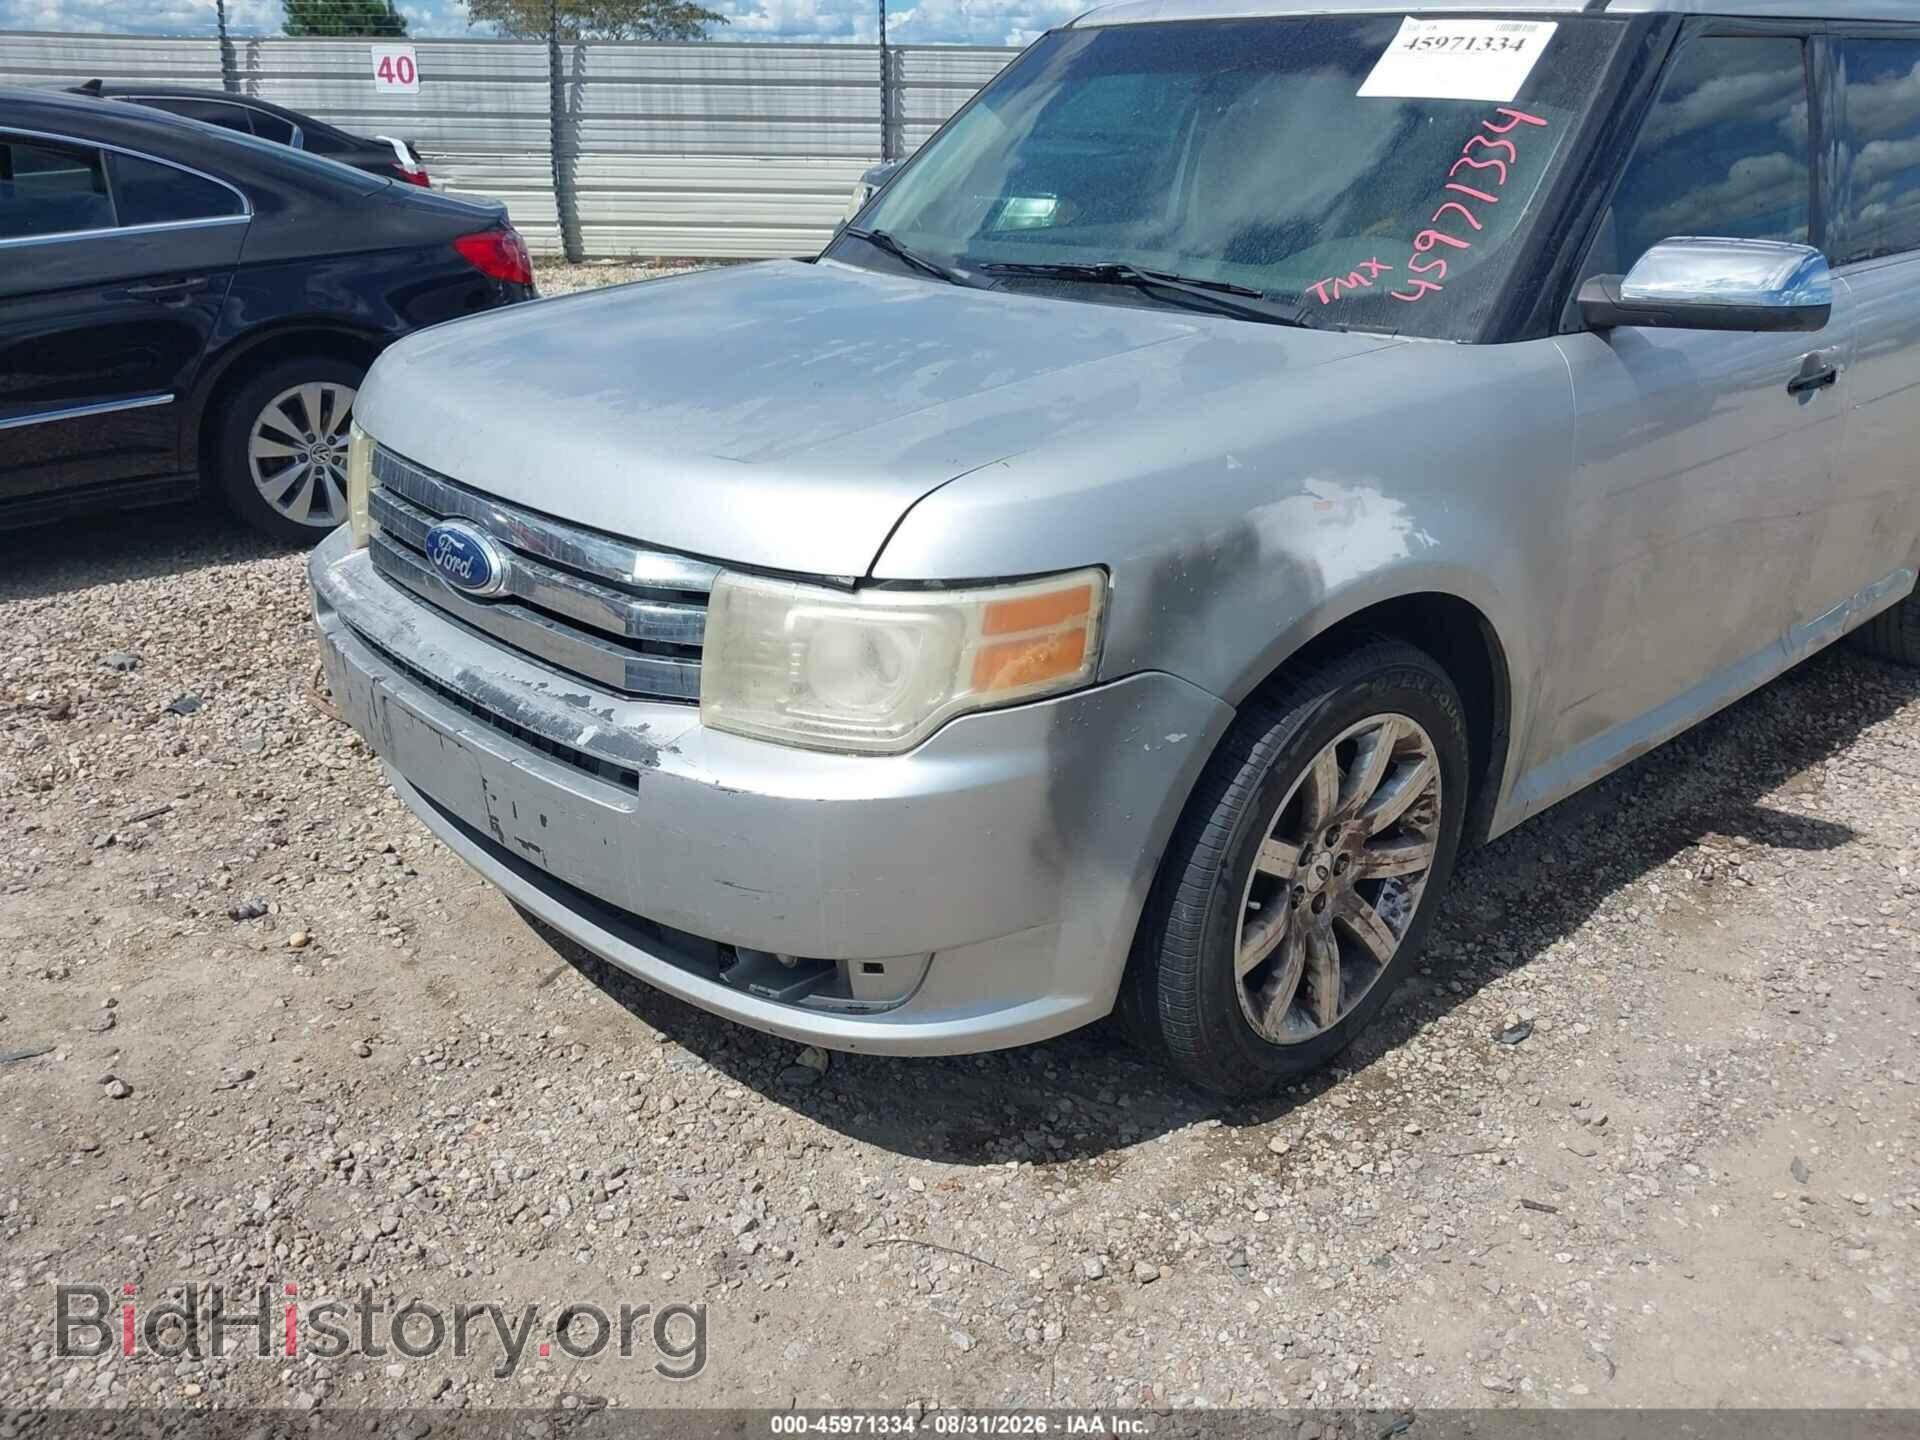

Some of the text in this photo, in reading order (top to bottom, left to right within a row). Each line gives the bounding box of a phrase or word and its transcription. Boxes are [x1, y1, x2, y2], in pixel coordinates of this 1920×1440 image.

[1403, 36, 1527, 52] 45971334
[377, 56, 415, 84] 40
[1391, 107, 1548, 301] 45971334
[1306, 257, 1393, 304] TMX
[433, 533, 474, 579] Ford
